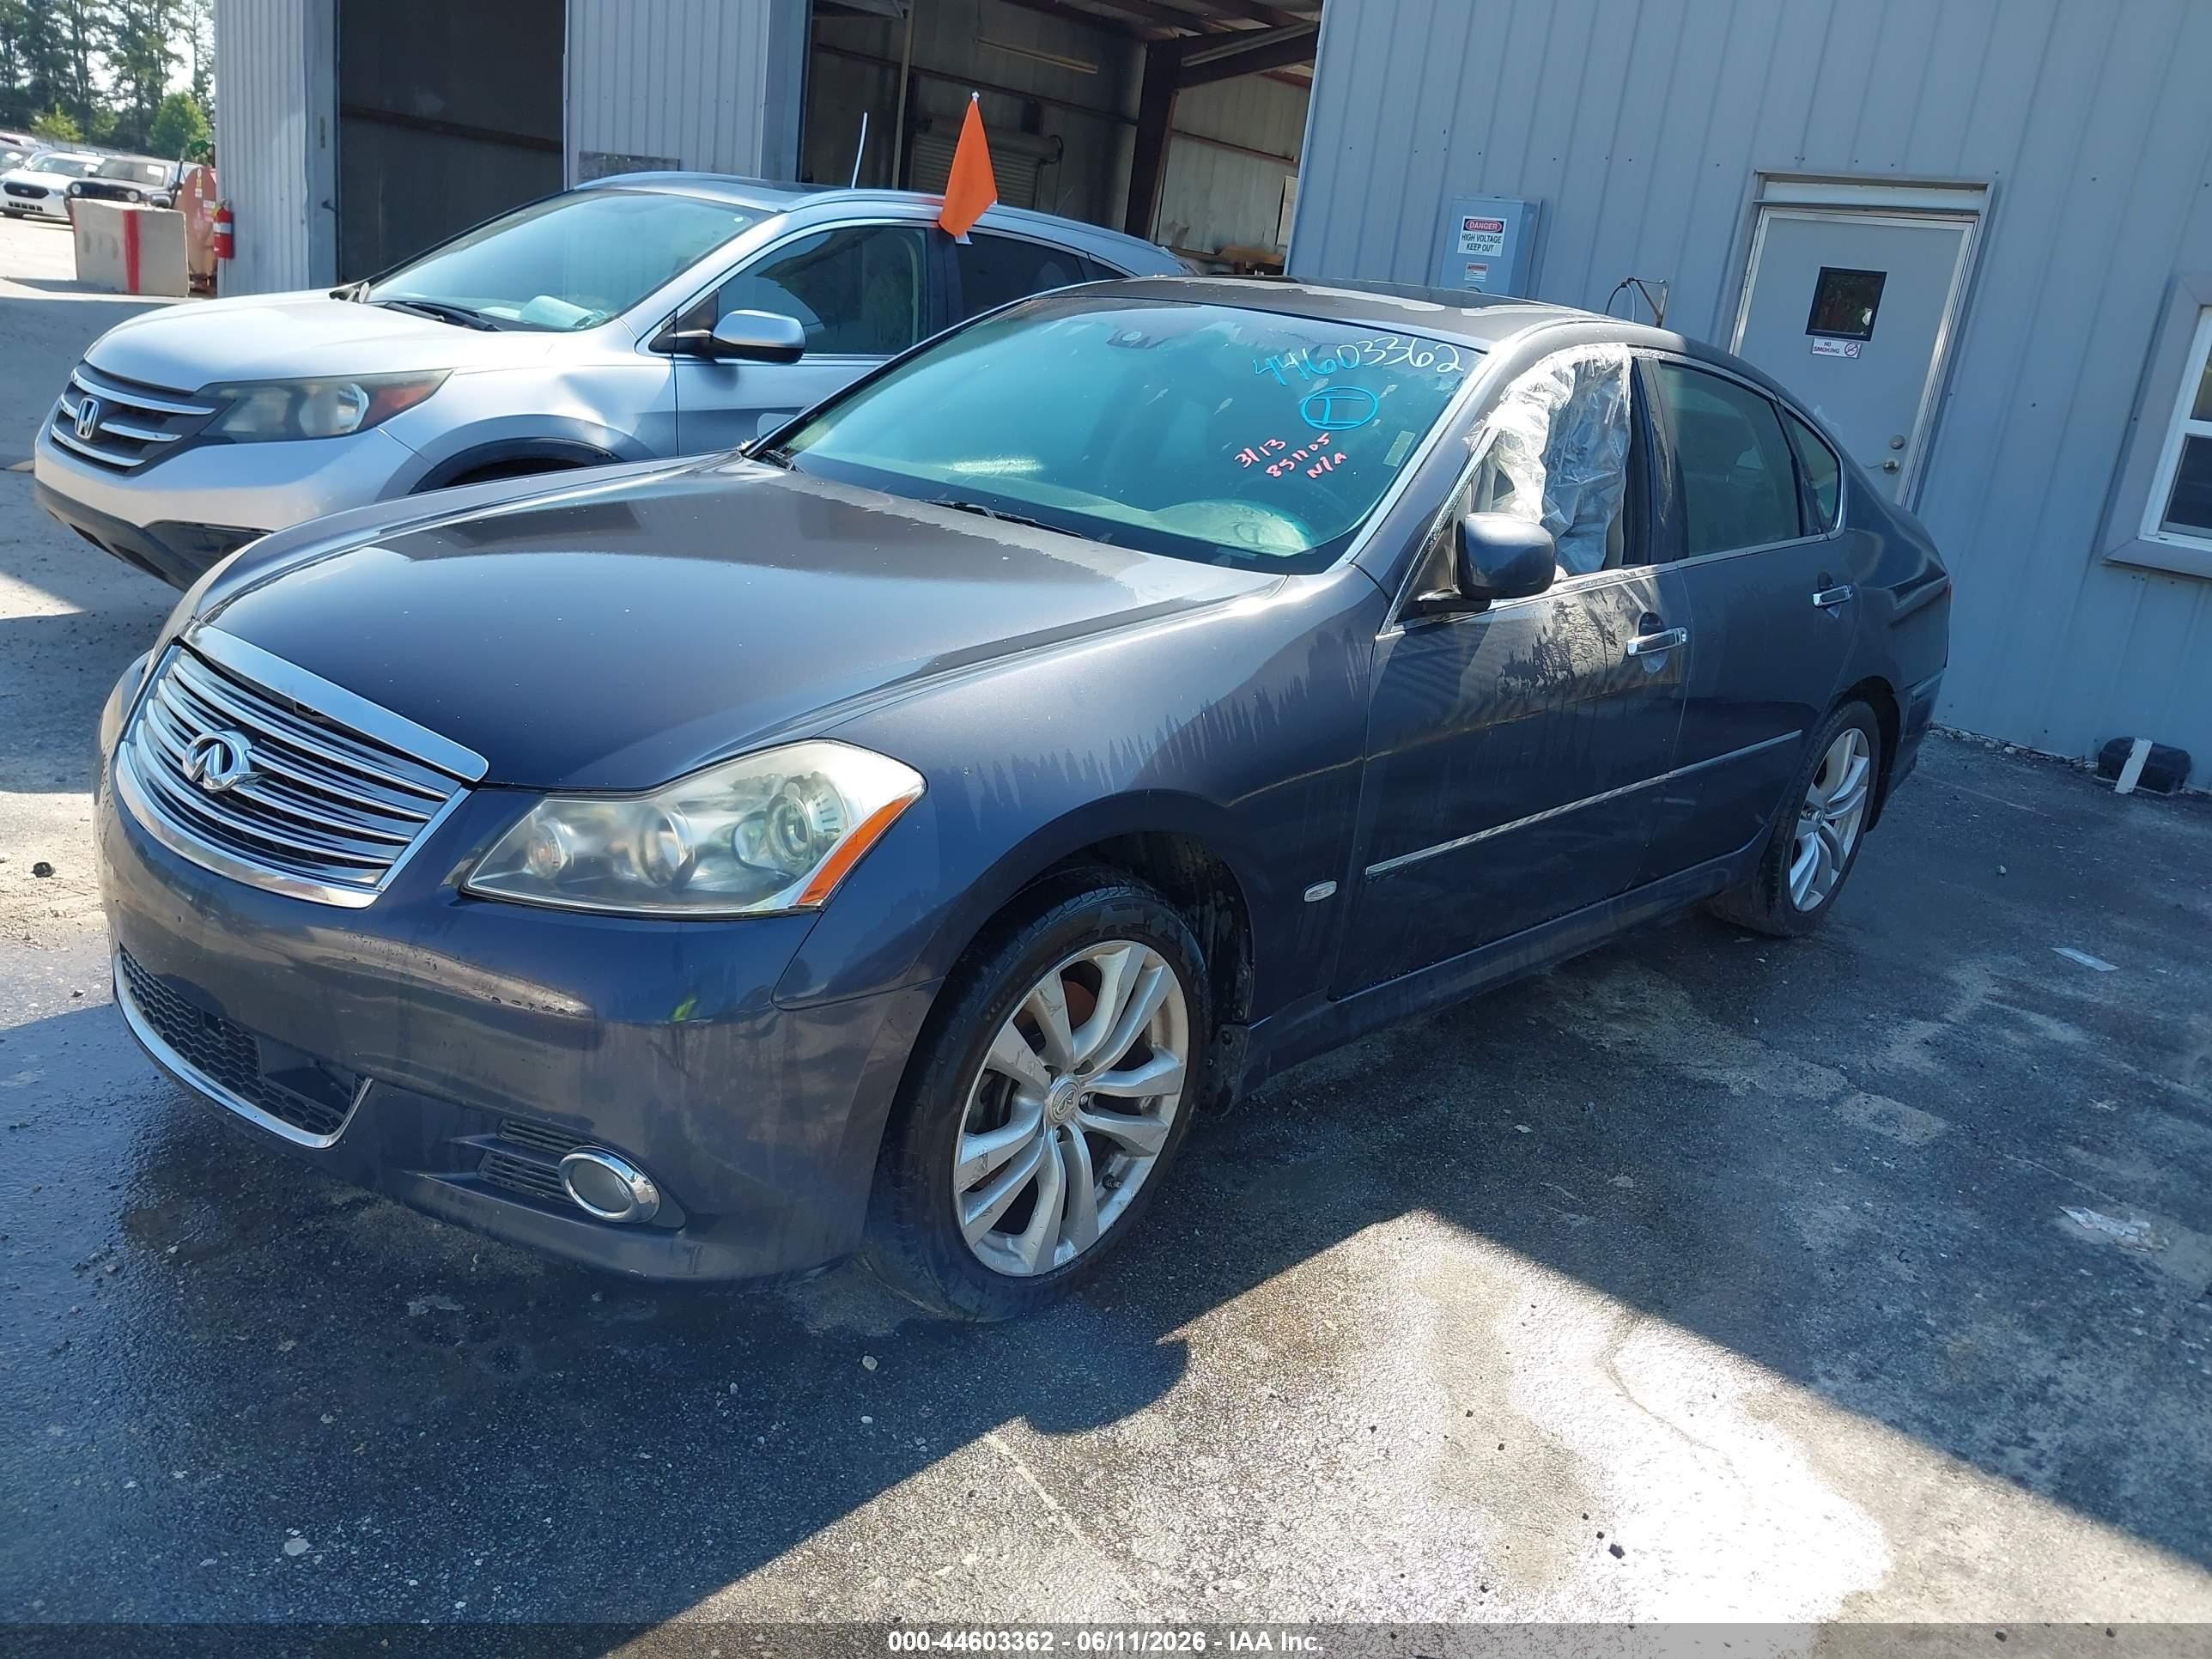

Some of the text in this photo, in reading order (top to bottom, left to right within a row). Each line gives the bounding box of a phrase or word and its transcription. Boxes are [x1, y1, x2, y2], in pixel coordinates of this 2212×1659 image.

[1469, 222, 1498, 230] DANGER
[1476, 234, 1502, 244] VOLTAGE
[1482, 244, 1494, 252] OUT
[1252, 336, 1464, 386] 44603362
[1306, 451, 1347, 479] N/A
